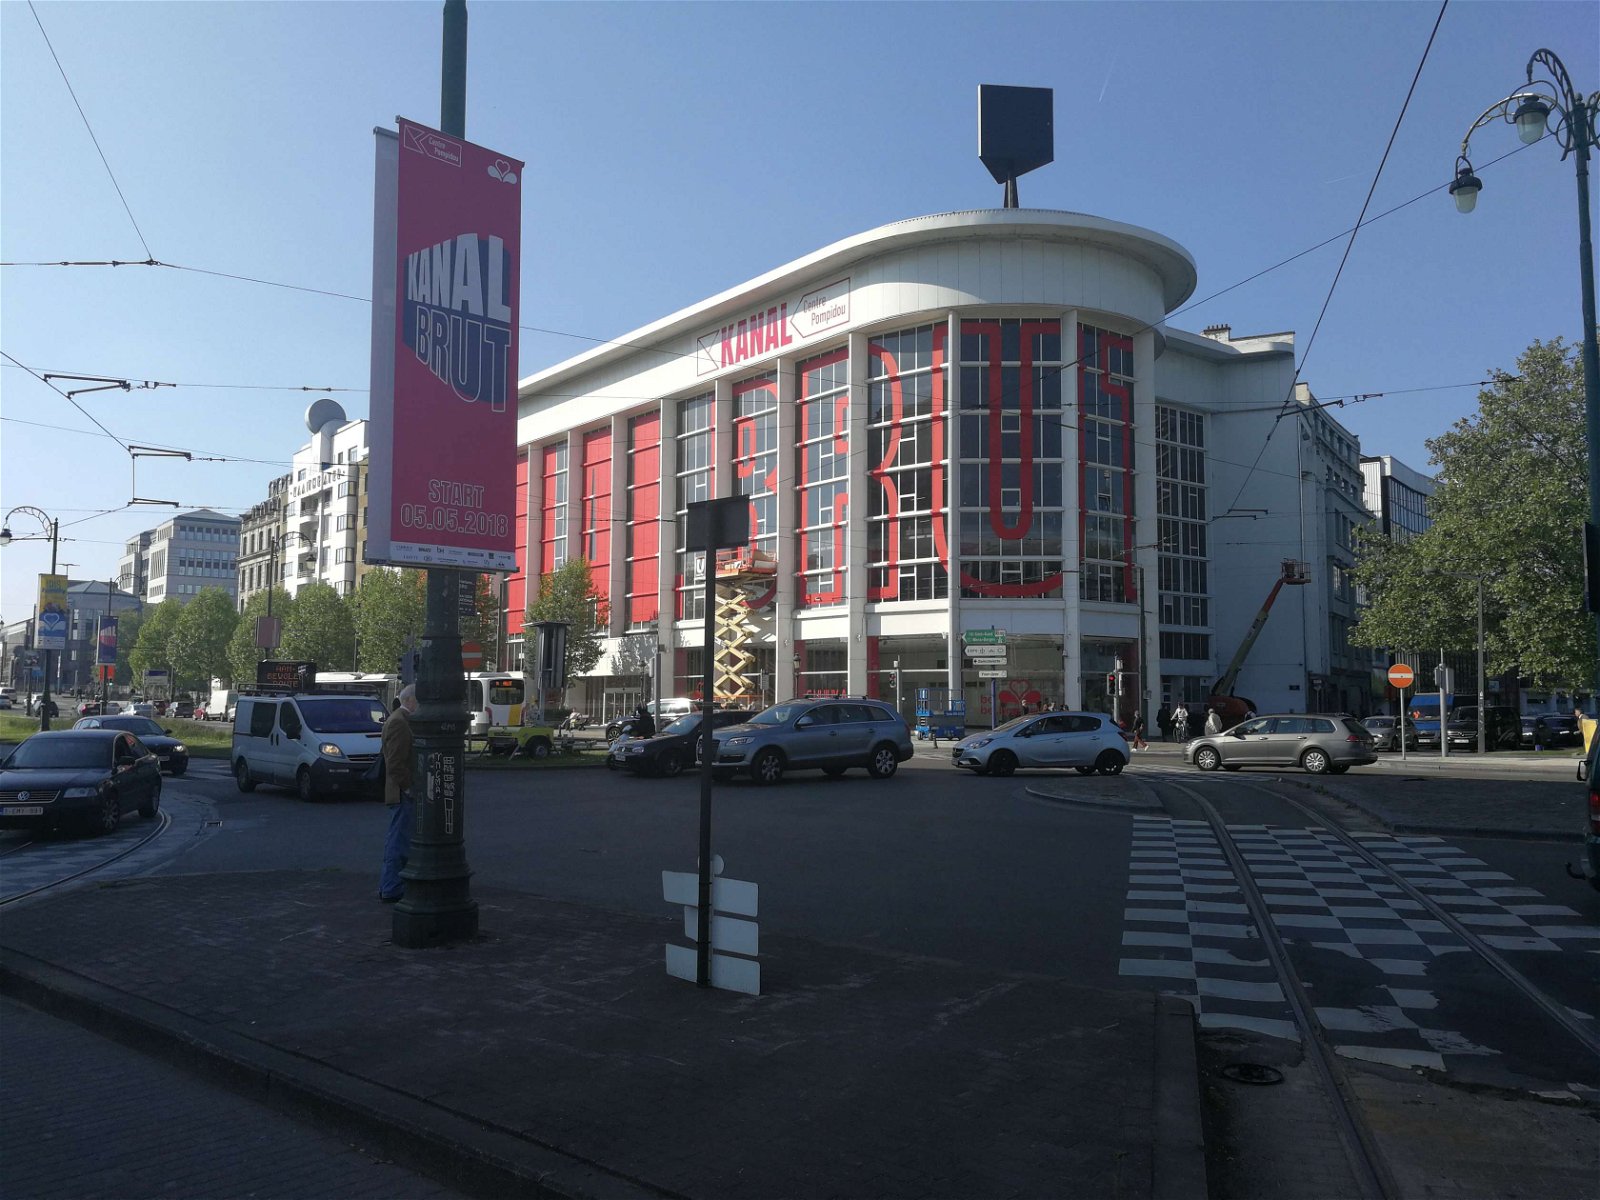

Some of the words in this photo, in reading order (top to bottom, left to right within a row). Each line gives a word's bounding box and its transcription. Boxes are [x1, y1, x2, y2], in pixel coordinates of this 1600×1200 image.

[434, 146, 459, 162] Pompidou
[407, 232, 512, 323] KANAL
[803, 295, 827, 313] Centre
[811, 304, 846, 326] Pompidou
[721, 302, 793, 368] KANAL
[415, 305, 512, 412] BRUT
[428, 479, 485, 509] START
[400, 503, 509, 537] 05.05.2018
